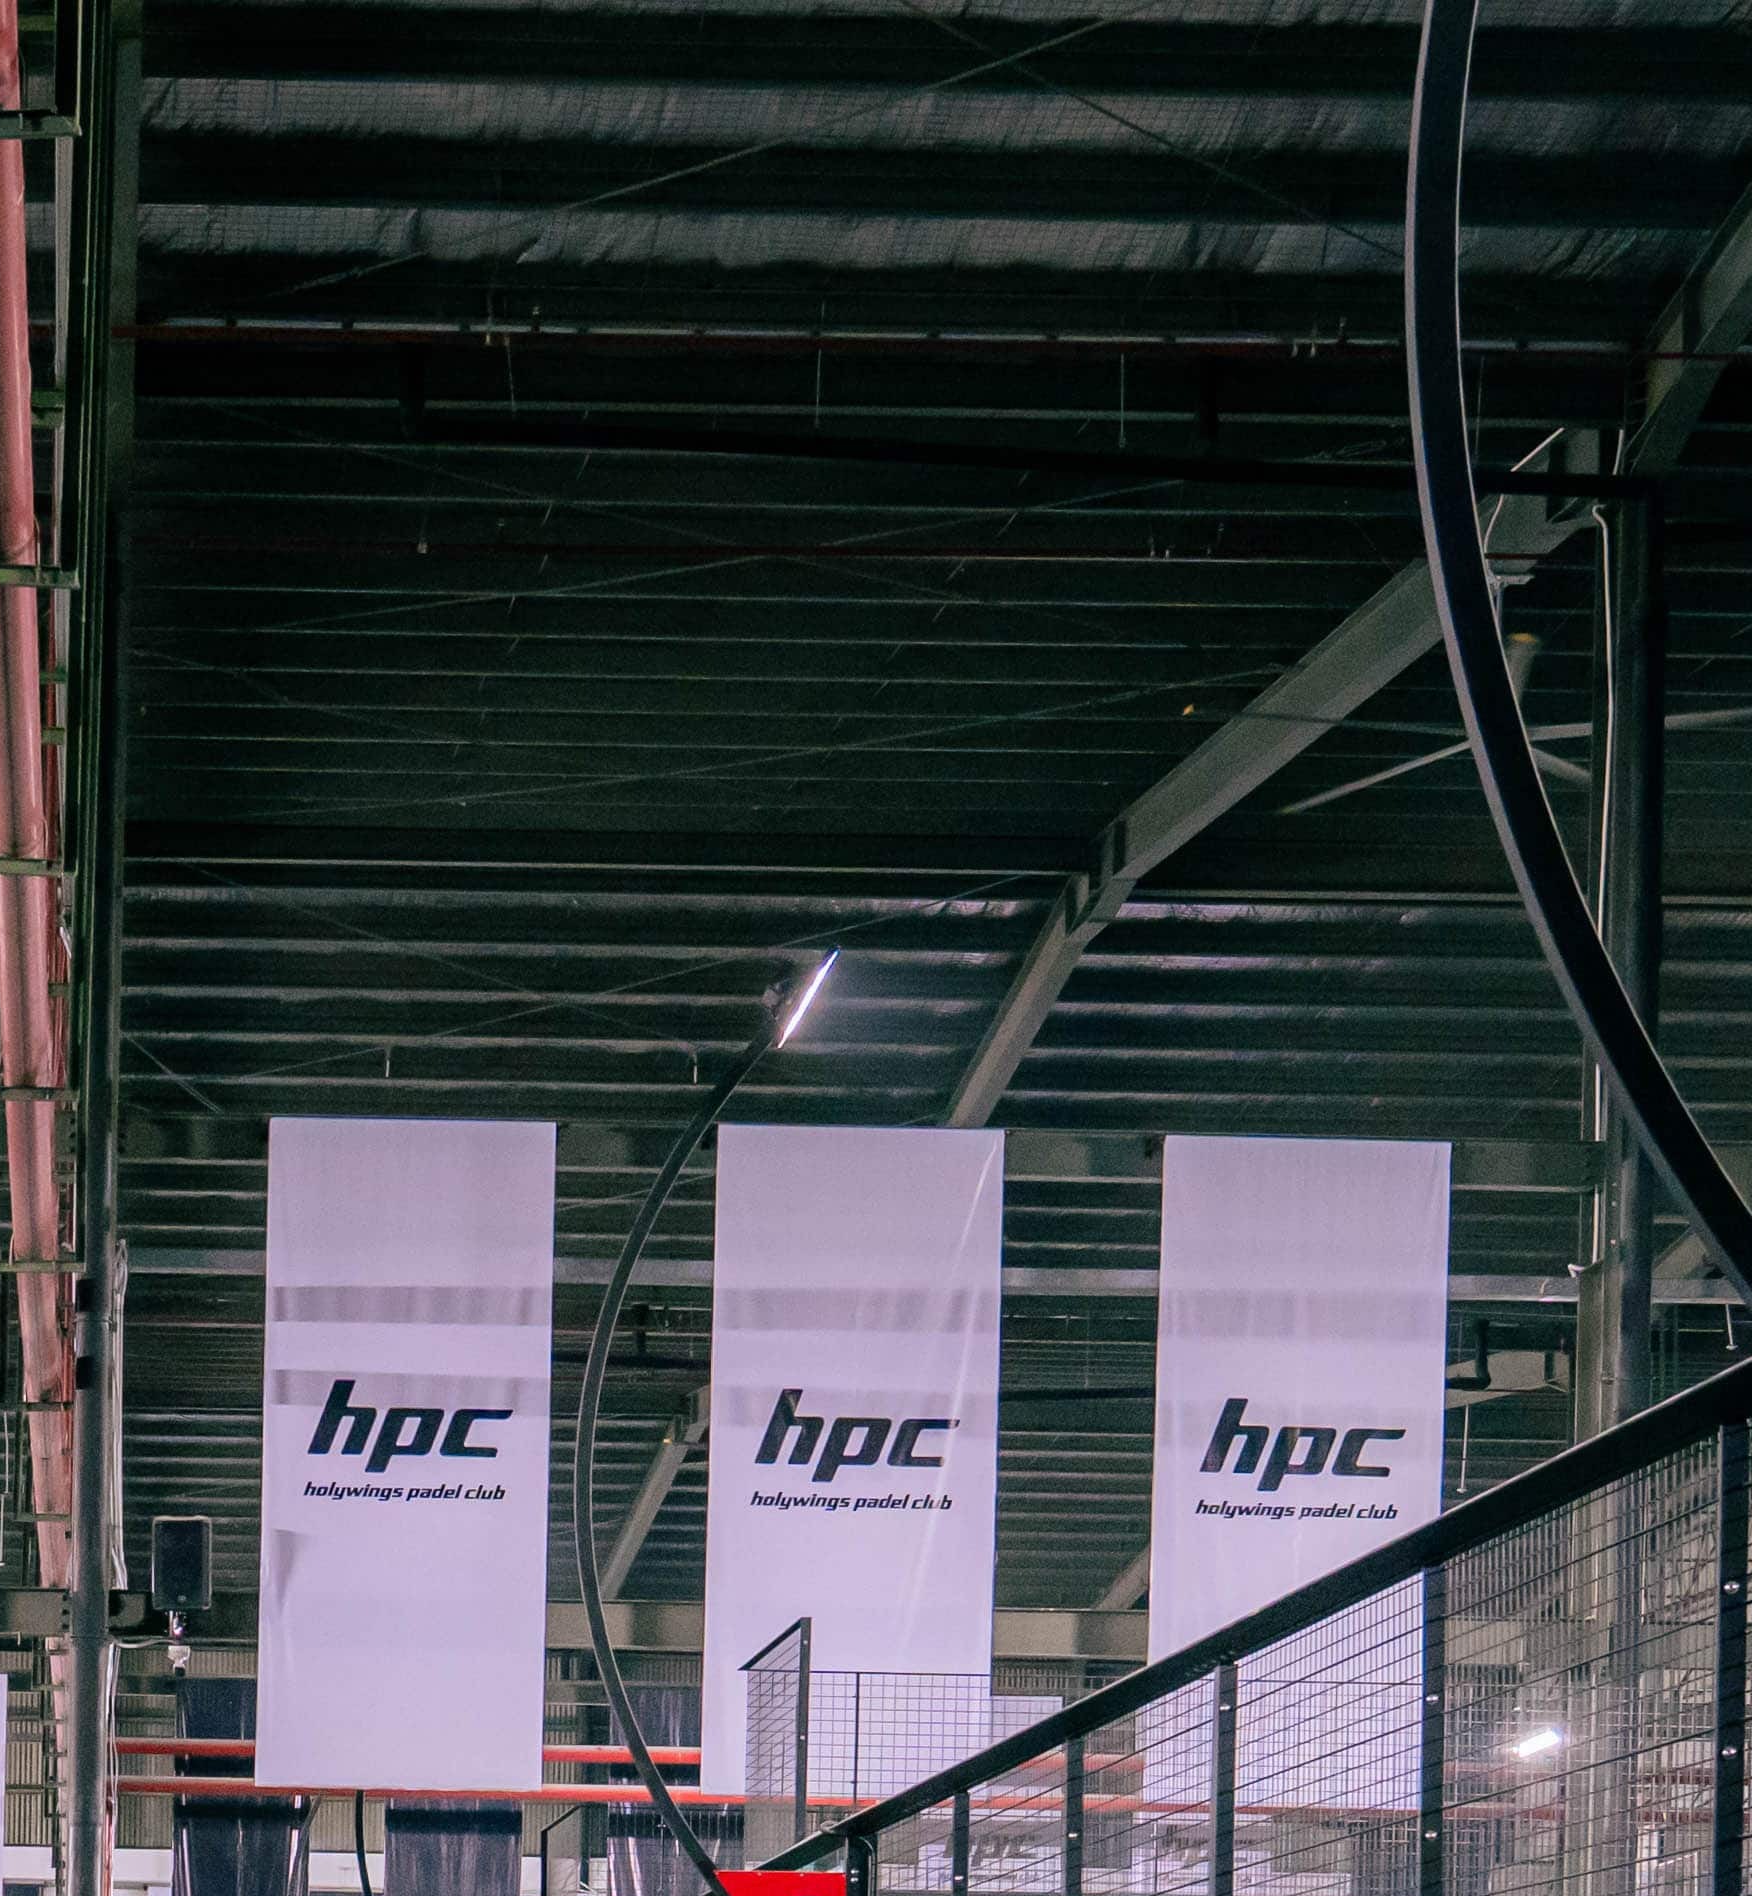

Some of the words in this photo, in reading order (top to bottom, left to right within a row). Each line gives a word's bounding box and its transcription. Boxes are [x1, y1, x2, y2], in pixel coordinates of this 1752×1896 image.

[308, 1379, 513, 1472] hpc
[755, 1389, 960, 1482] hpc
[1200, 1398, 1406, 1491] hpc
[304, 1482, 403, 1501] holywings
[406, 1484, 463, 1501] padel
[464, 1485, 506, 1500] club
[750, 1491, 851, 1511] holywings
[853, 1494, 909, 1511] padel
[911, 1495, 953, 1510] club
[1196, 1500, 1295, 1519] holywings
[1299, 1503, 1354, 1519] padel
[1356, 1504, 1398, 1519] club
